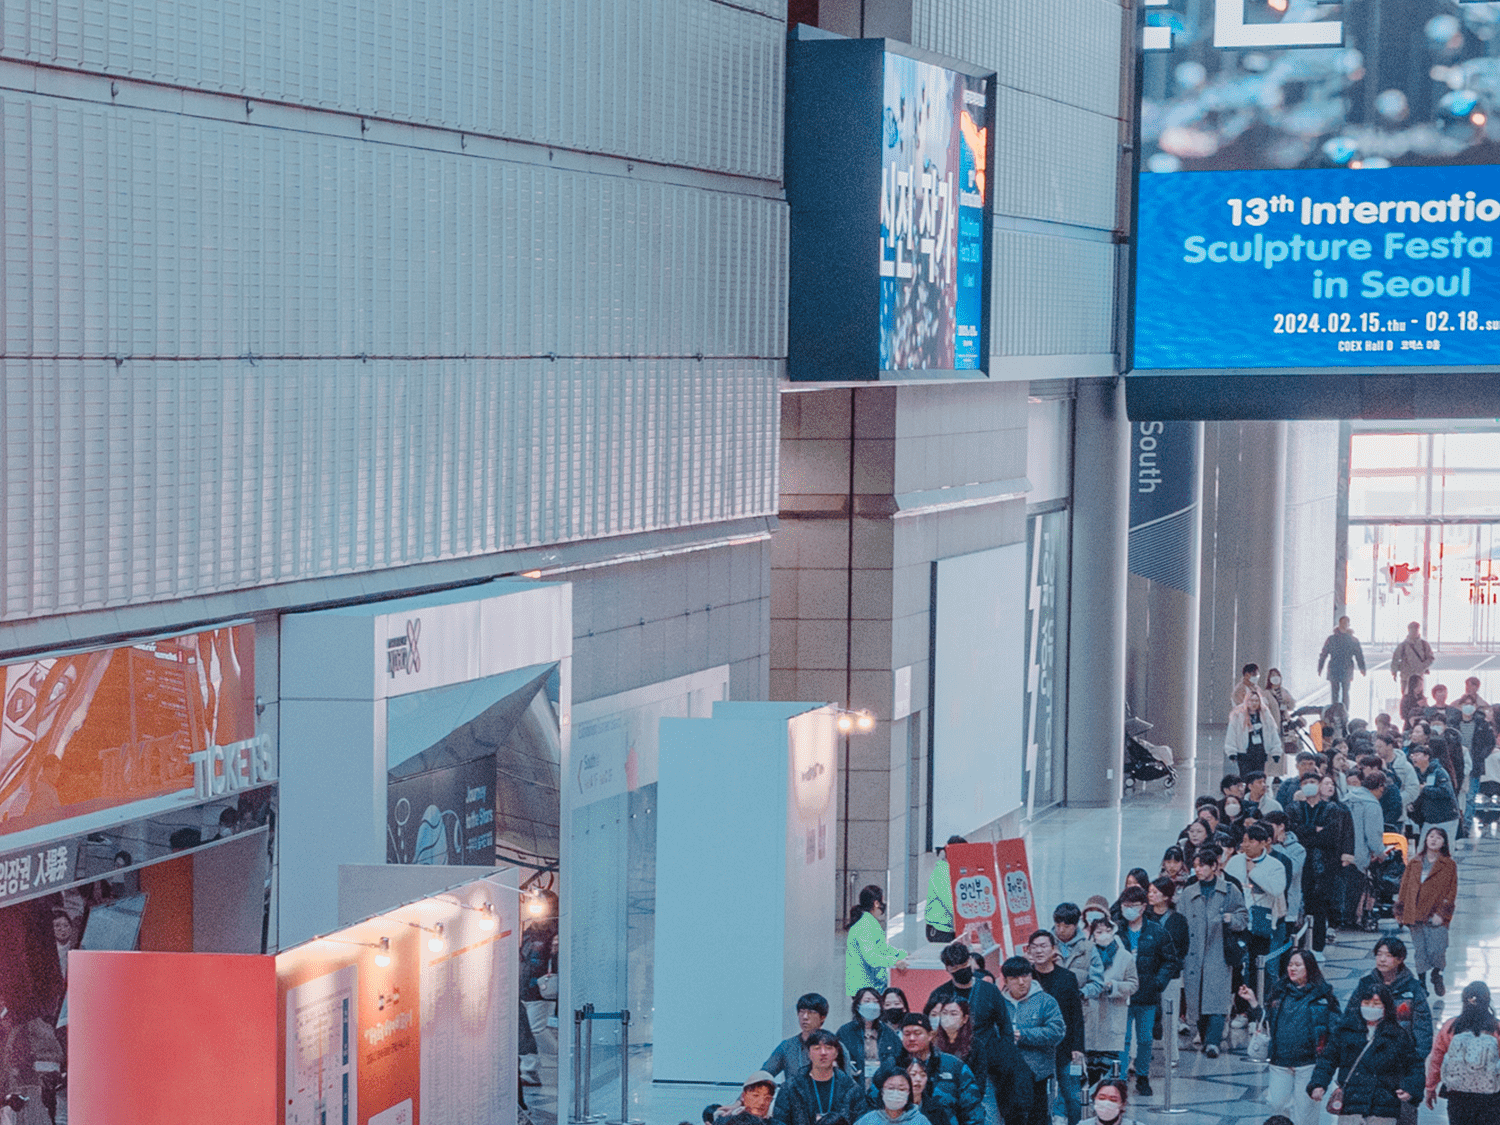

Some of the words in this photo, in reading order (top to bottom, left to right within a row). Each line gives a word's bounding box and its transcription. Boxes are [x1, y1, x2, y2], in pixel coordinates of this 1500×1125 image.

[1226, 194, 1295, 226] 13th
[1301, 191, 1500, 225] Internatio
[1183, 232, 1373, 269] Sculpture
[1384, 230, 1493, 260] Festa
[1312, 268, 1348, 299] in
[1360, 266, 1471, 298] Seoul
[1338, 340, 1363, 352] COEX
[1365, 340, 1384, 351] Hall
[1386, 339, 1394, 351] D
[1138, 421, 1164, 493] South
[189, 733, 273, 801] TICKETS
